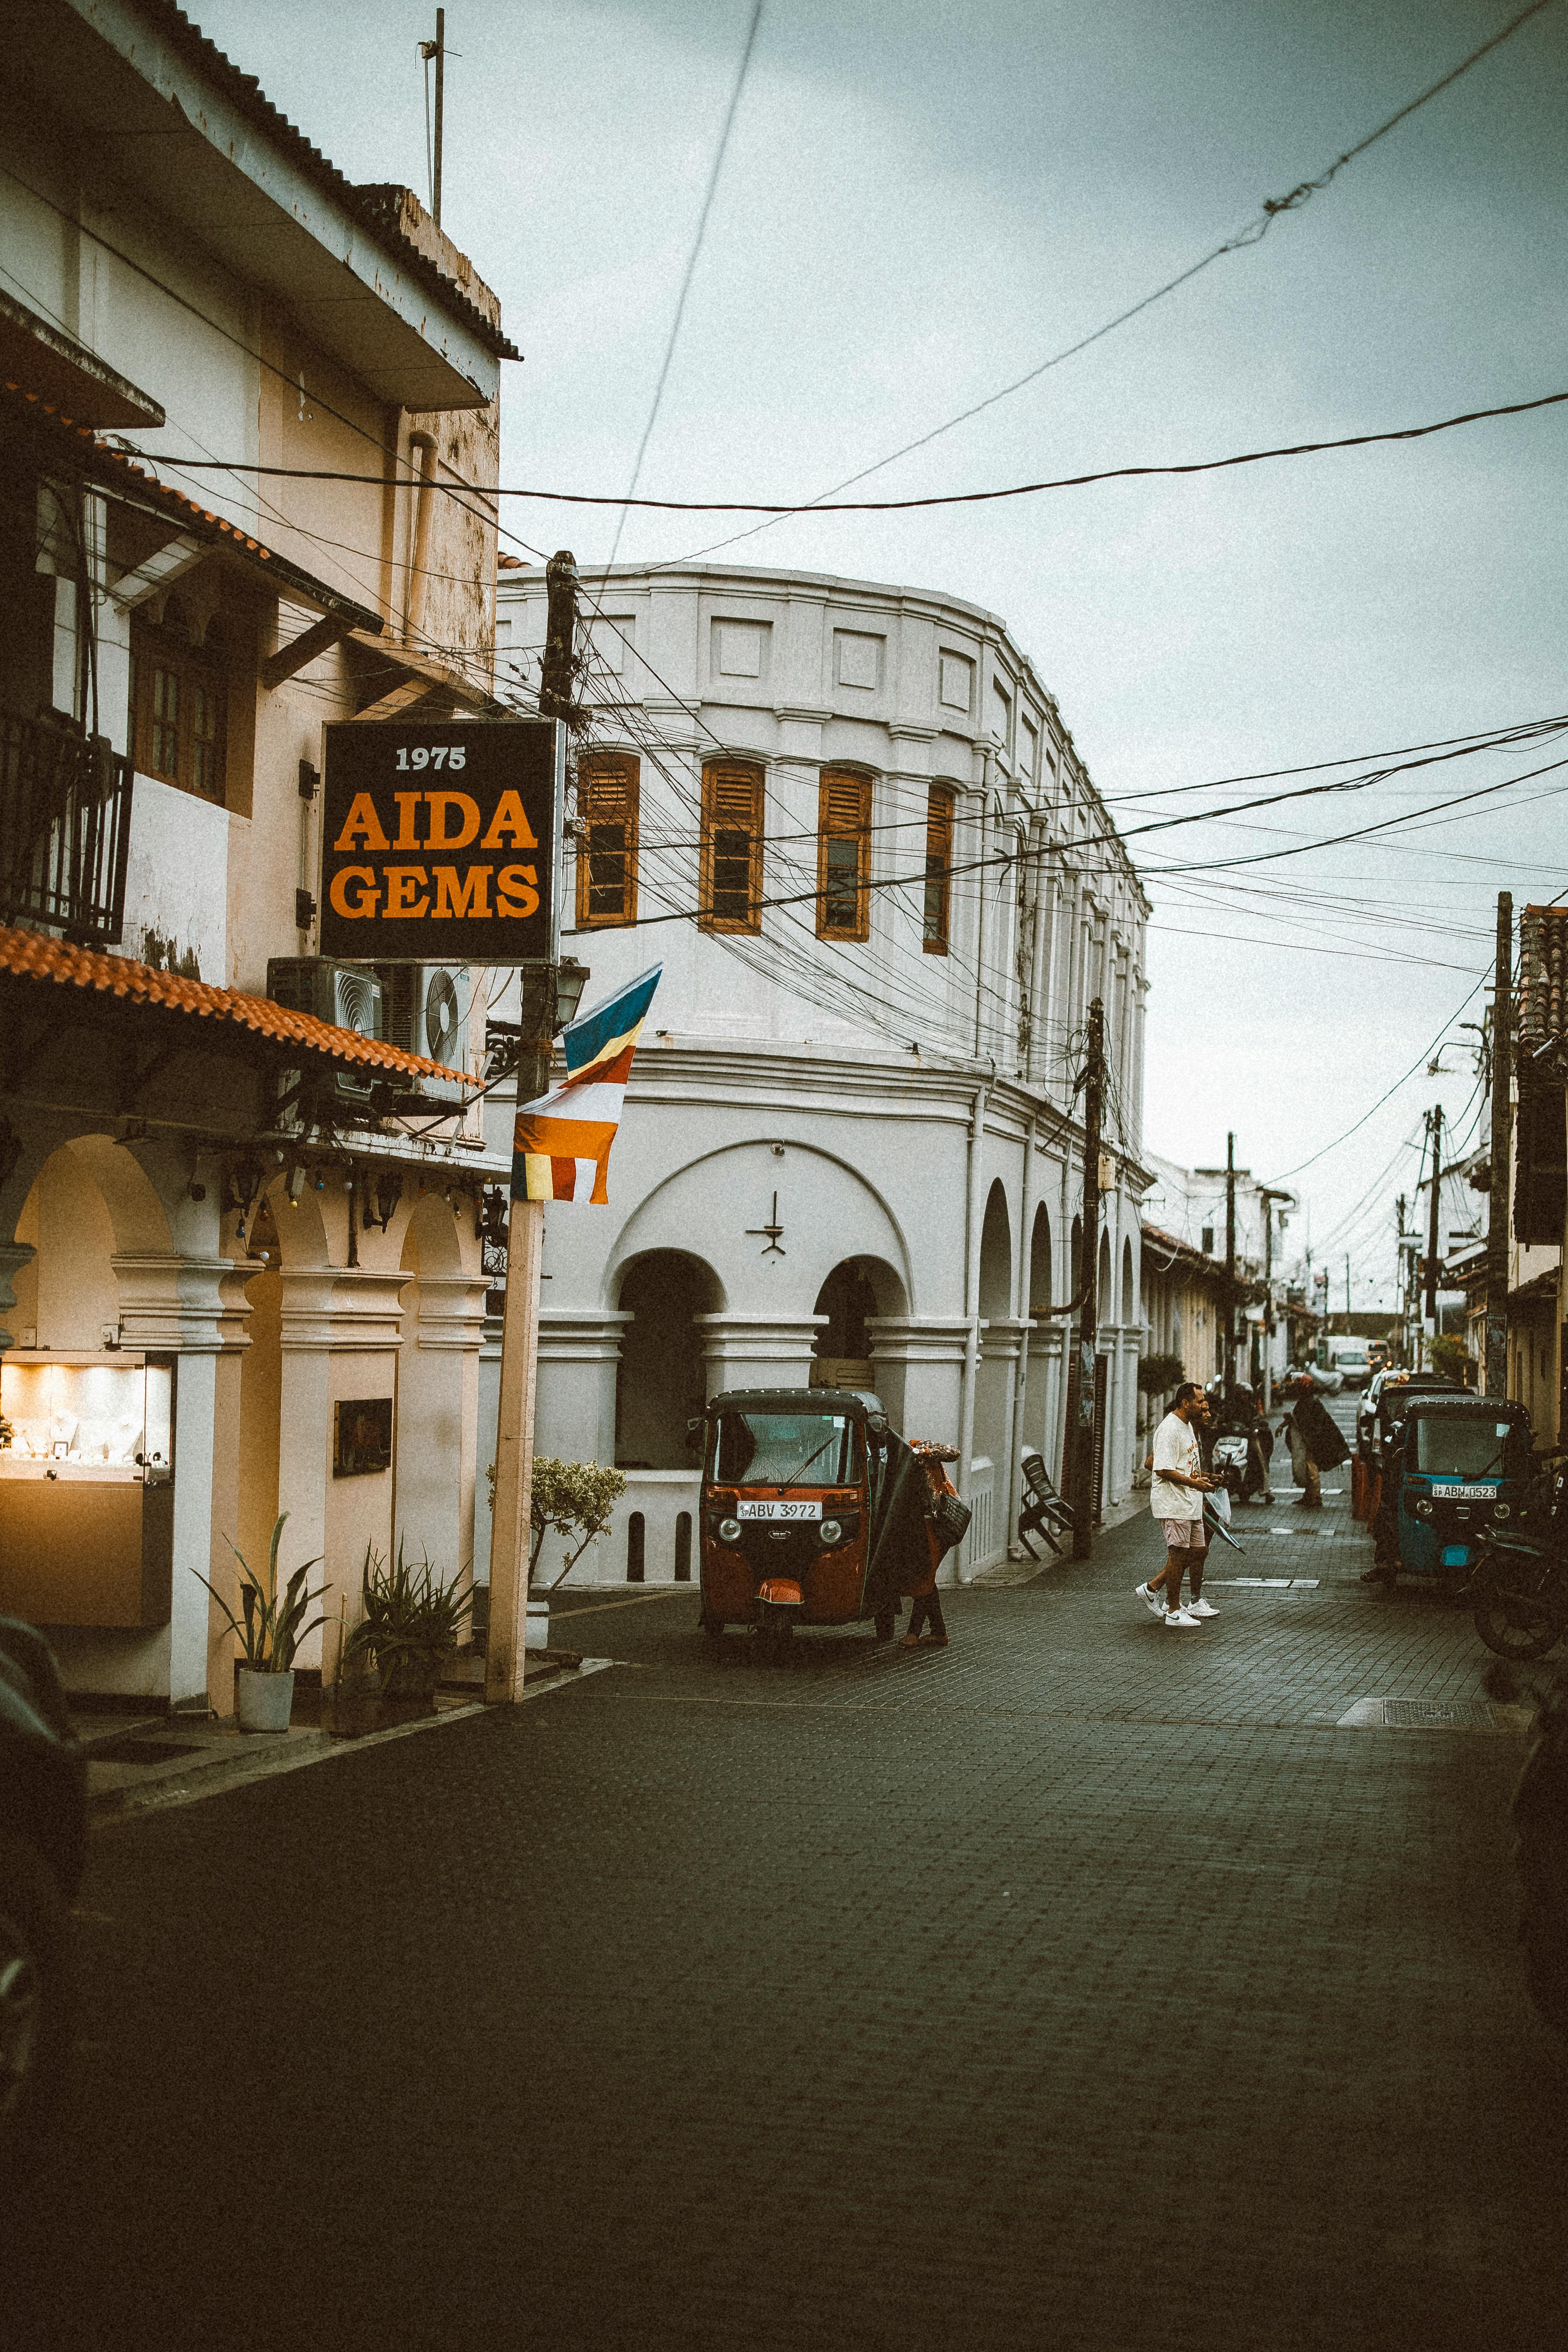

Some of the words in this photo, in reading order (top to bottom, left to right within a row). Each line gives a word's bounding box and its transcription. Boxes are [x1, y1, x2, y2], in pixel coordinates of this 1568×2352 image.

[396, 747, 466, 770] 1975
[334, 790, 538, 851] AIDA
[330, 864, 539, 919] GEMS
[1469, 1487, 1495, 1498] 0523
[748, 1504, 775, 1517] ABV
[780, 1504, 816, 1517] 3972
